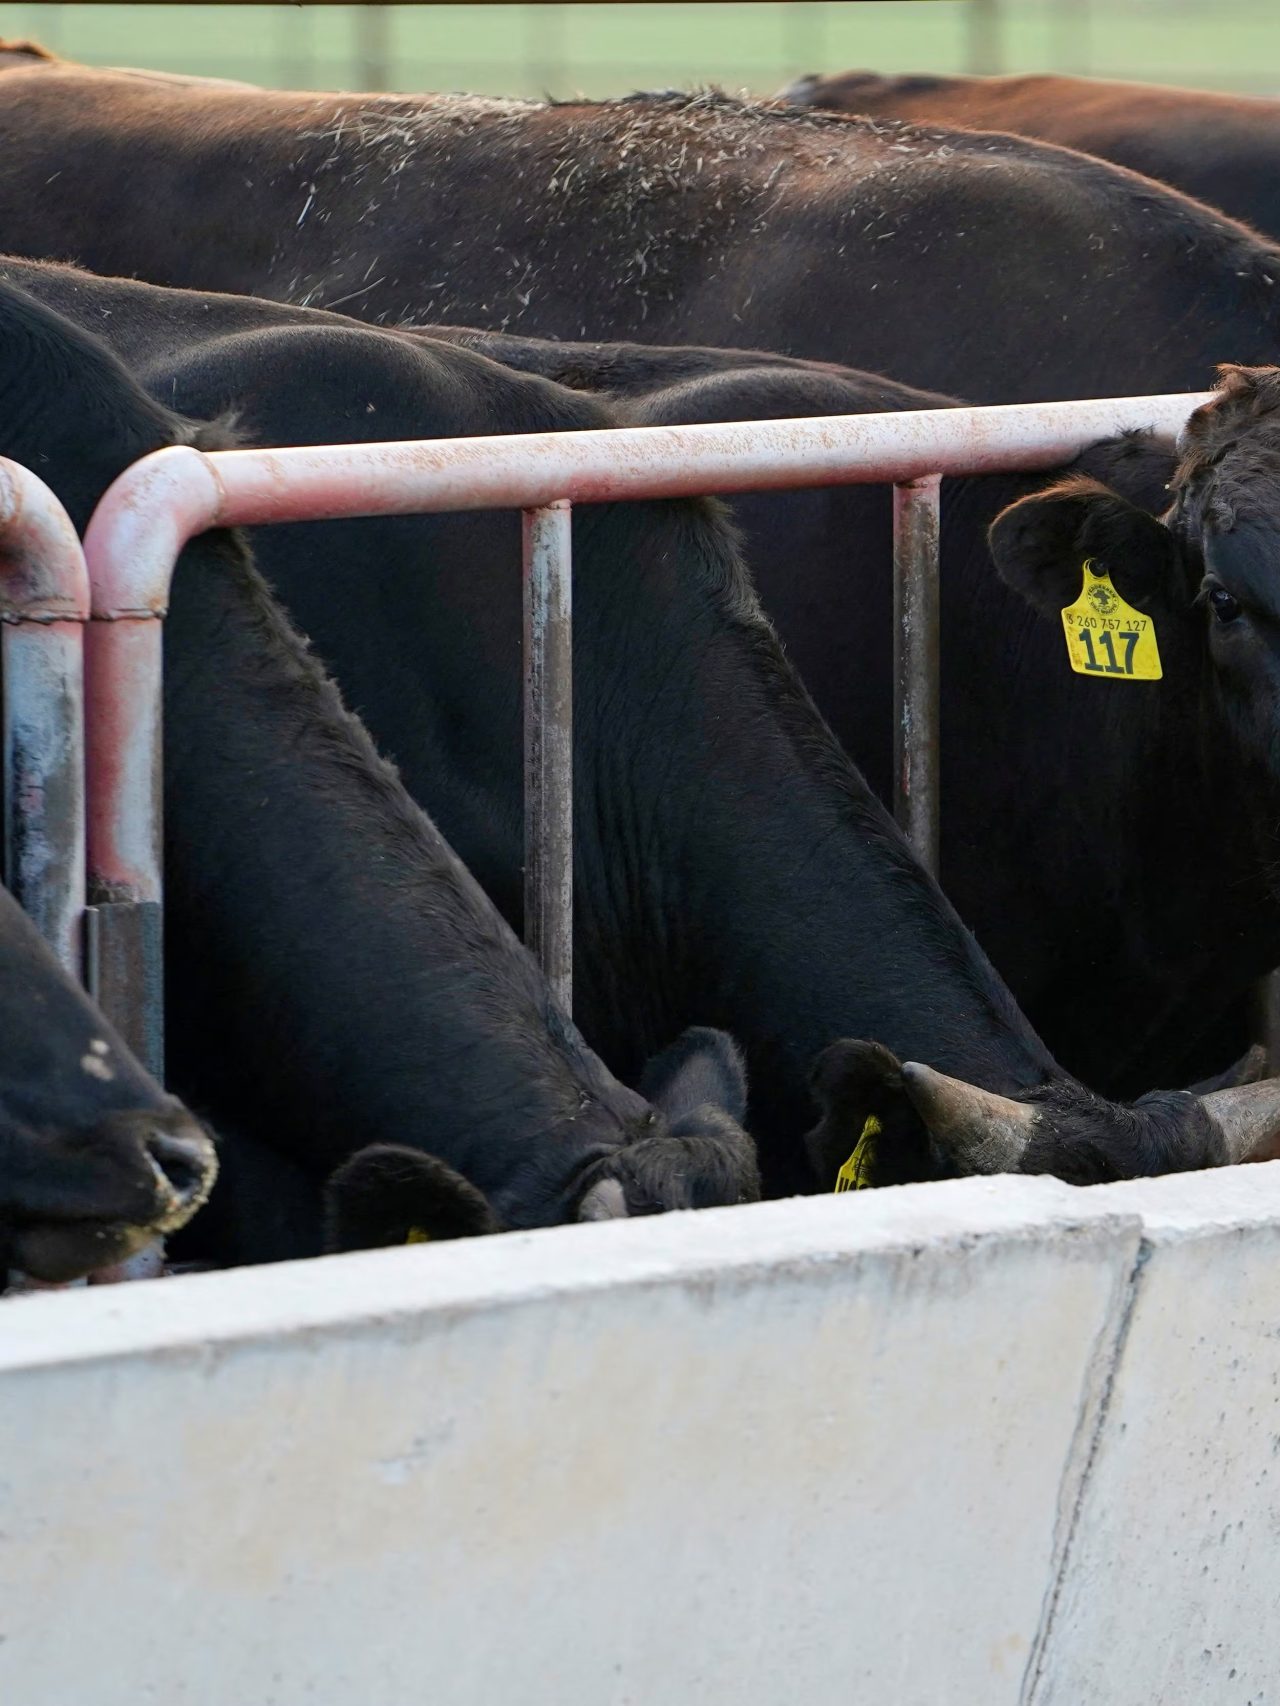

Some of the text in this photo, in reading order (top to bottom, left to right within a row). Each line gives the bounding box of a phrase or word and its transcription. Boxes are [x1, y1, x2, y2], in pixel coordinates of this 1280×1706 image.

[1077, 615, 1097, 628] 260
[1100, 618, 1121, 630] 757
[1126, 620, 1147, 632] 127
[1079, 628, 1140, 675] 117
